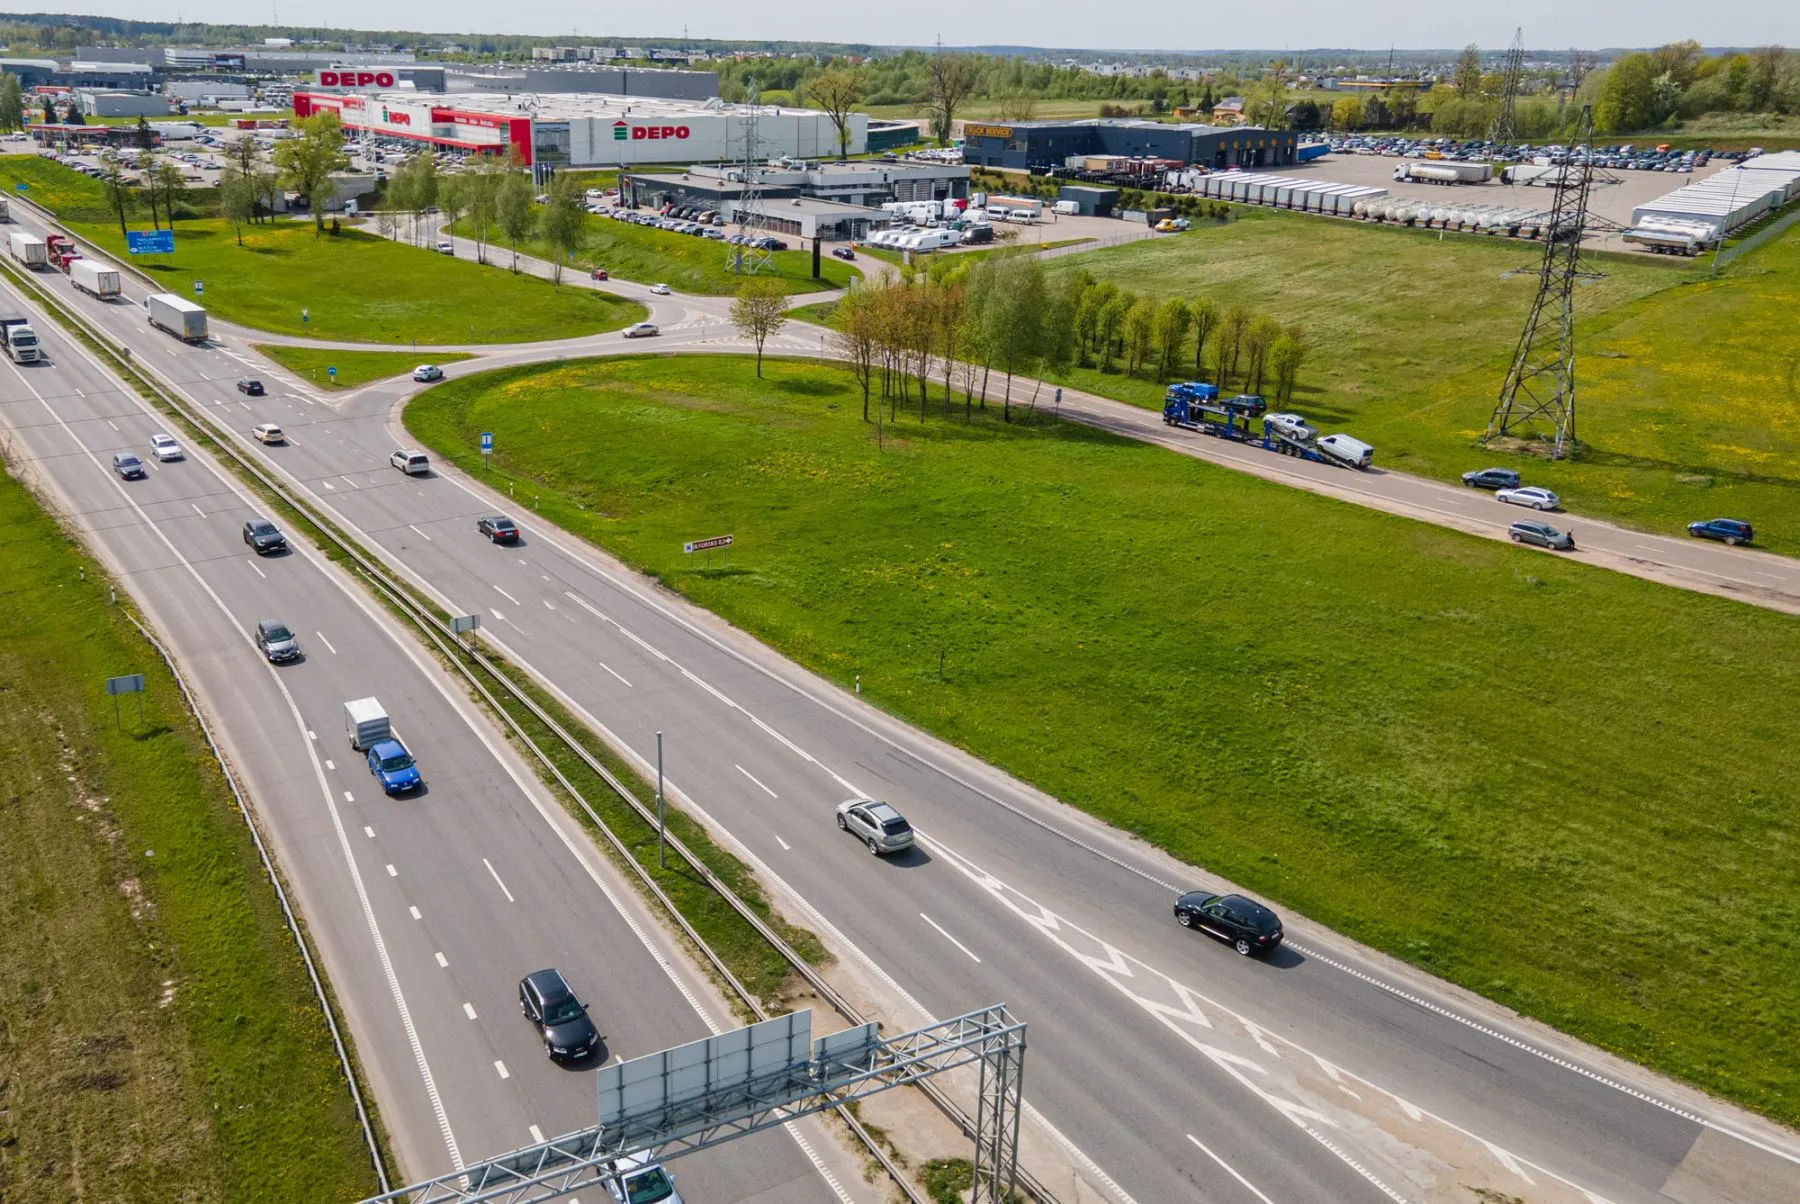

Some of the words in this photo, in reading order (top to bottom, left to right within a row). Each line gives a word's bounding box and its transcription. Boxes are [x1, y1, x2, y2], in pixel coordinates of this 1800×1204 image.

[320, 72, 394, 88] DEPO
[388, 111, 411, 126] DEPO
[631, 126, 690, 140] DEPO
[966, 127, 984, 136] TRUCK
[986, 128, 1009, 137] SERVICE
